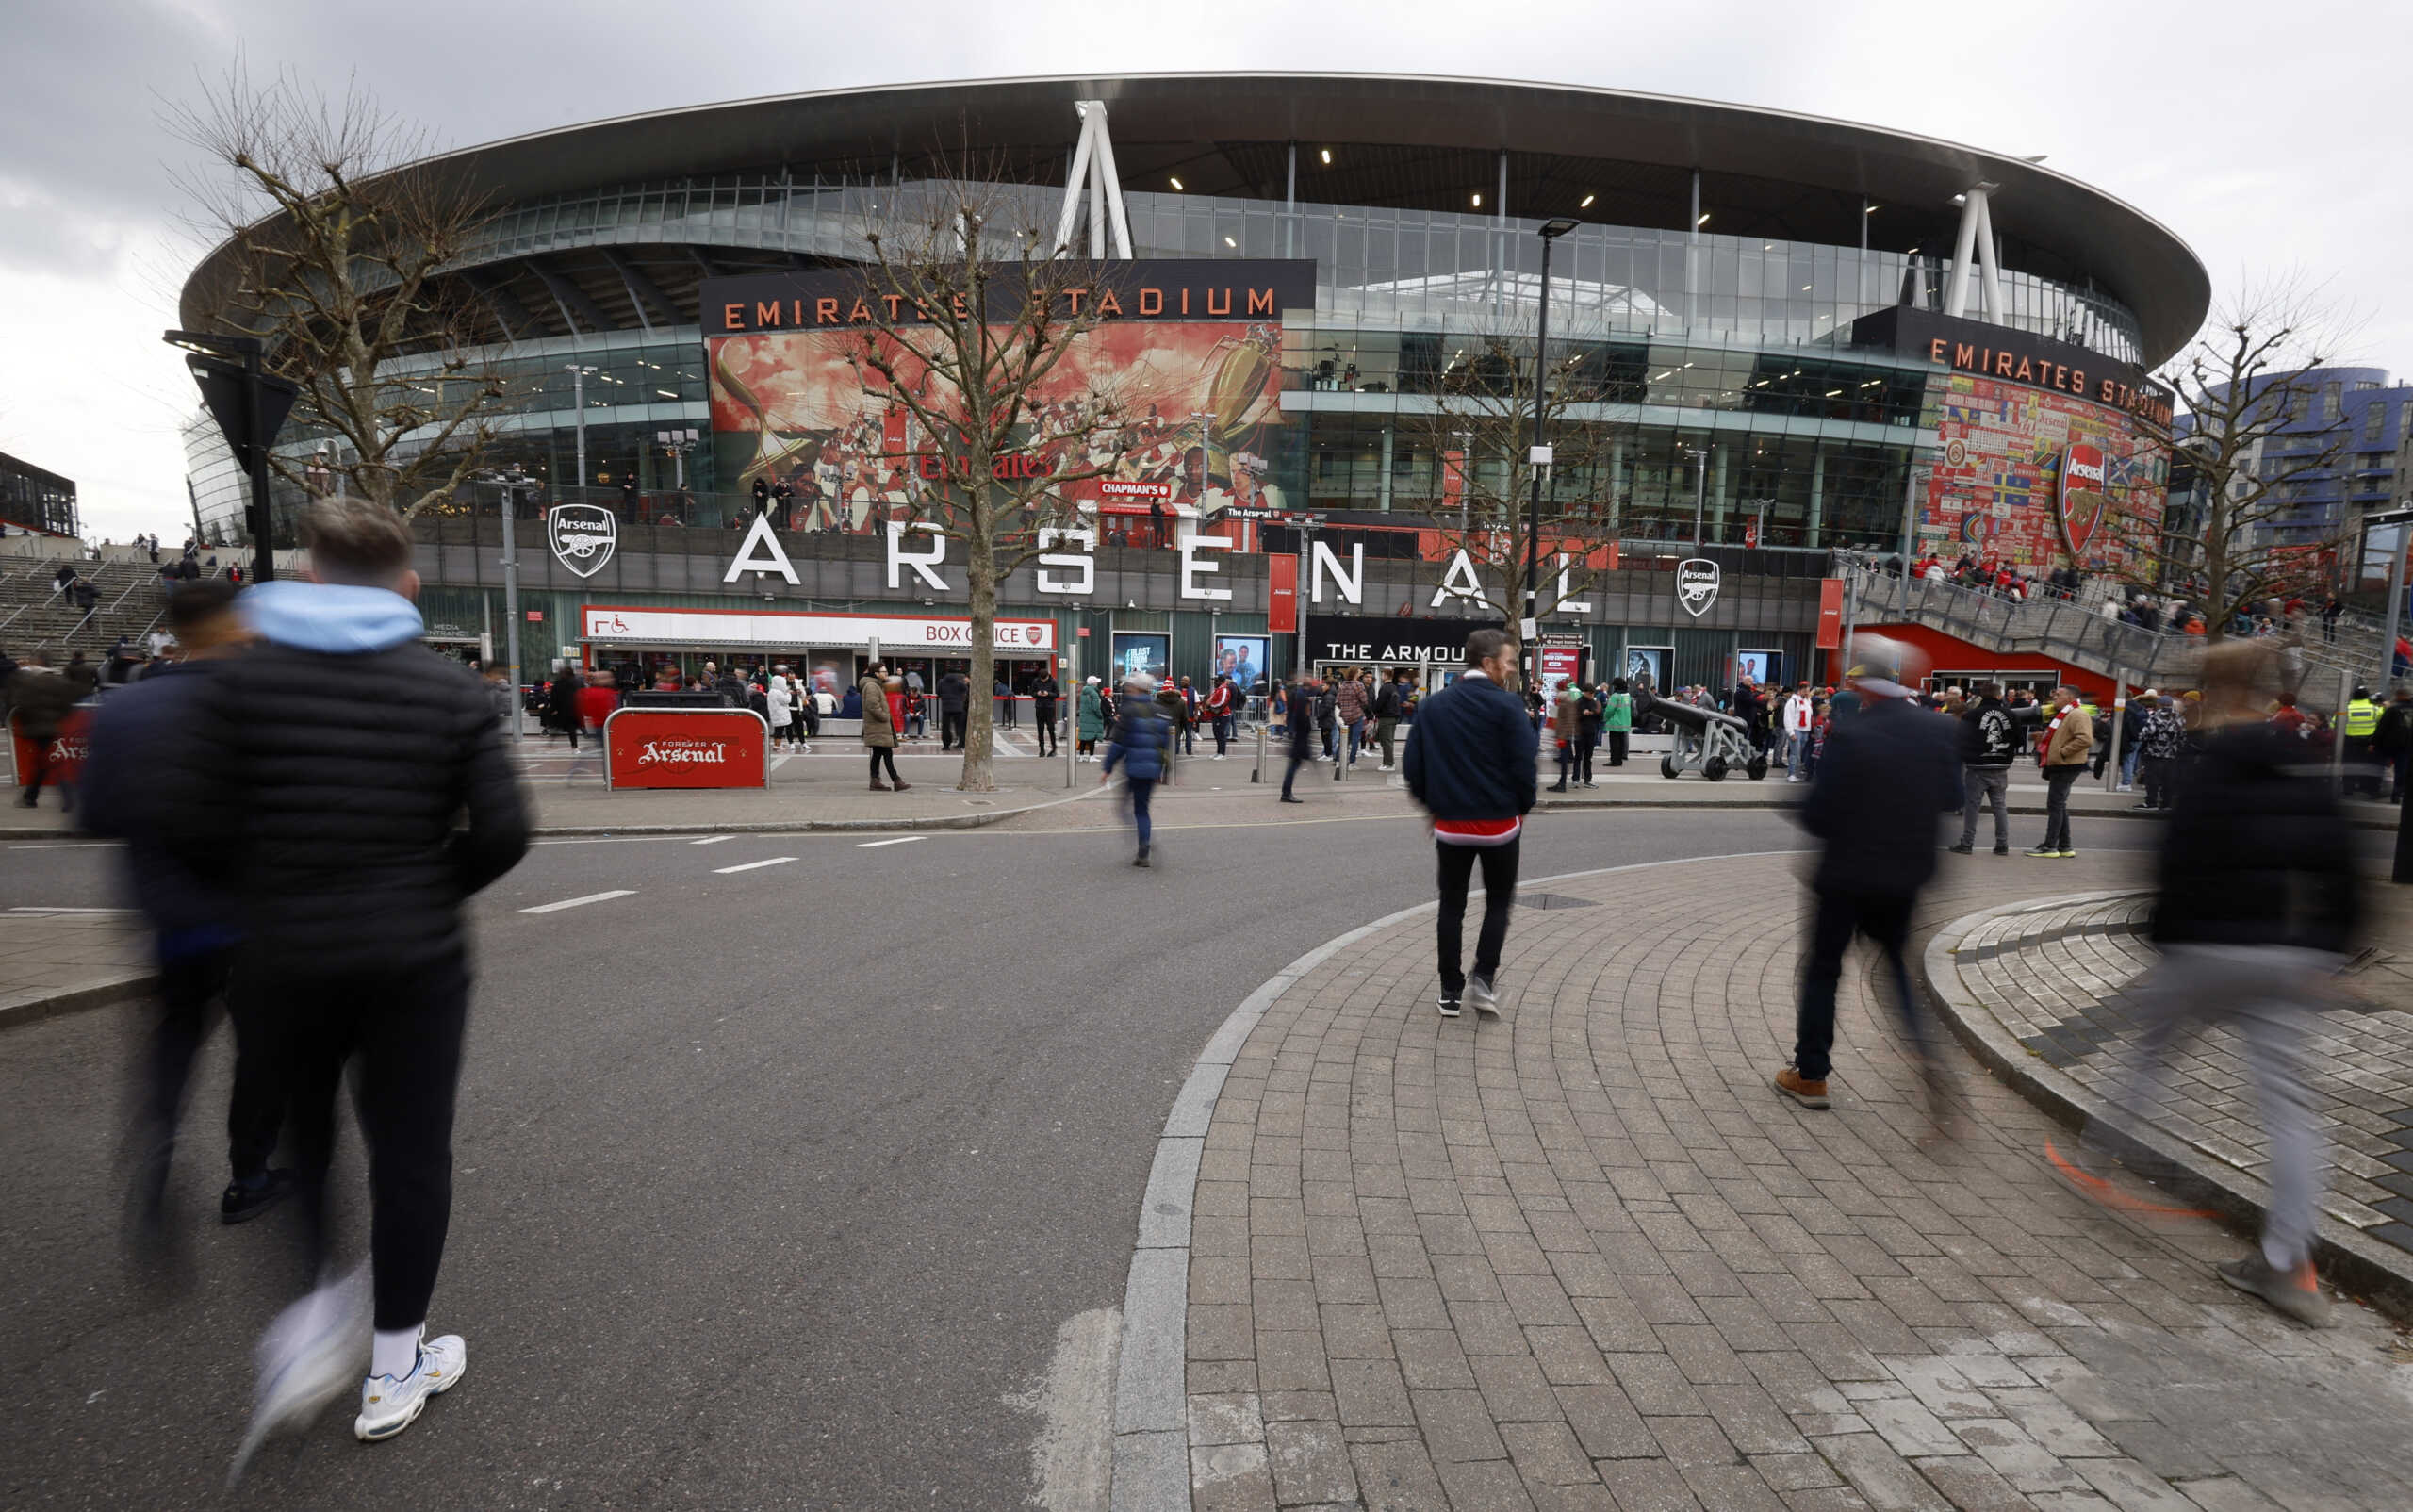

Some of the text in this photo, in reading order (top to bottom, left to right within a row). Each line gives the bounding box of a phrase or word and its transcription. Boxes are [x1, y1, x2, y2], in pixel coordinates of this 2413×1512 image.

[725, 292, 969, 329] EMIRATES
[1931, 338, 2173, 431] EMIRATES STADIUM
[920, 452, 1053, 480] Emates
[1102, 483, 1158, 496] CHAPMAN'S
[1228, 508, 1242, 517] The
[1243, 509, 1272, 518] Arsenal
[557, 518, 607, 532] Arsenal
[723, 511, 1591, 614] ARSENAL
[1683, 568, 1715, 581] Arsenal
[927, 626, 1019, 643] BOX OICE
[1327, 643, 1466, 661] THE ARMOU
[638, 741, 726, 765] Arsenal
